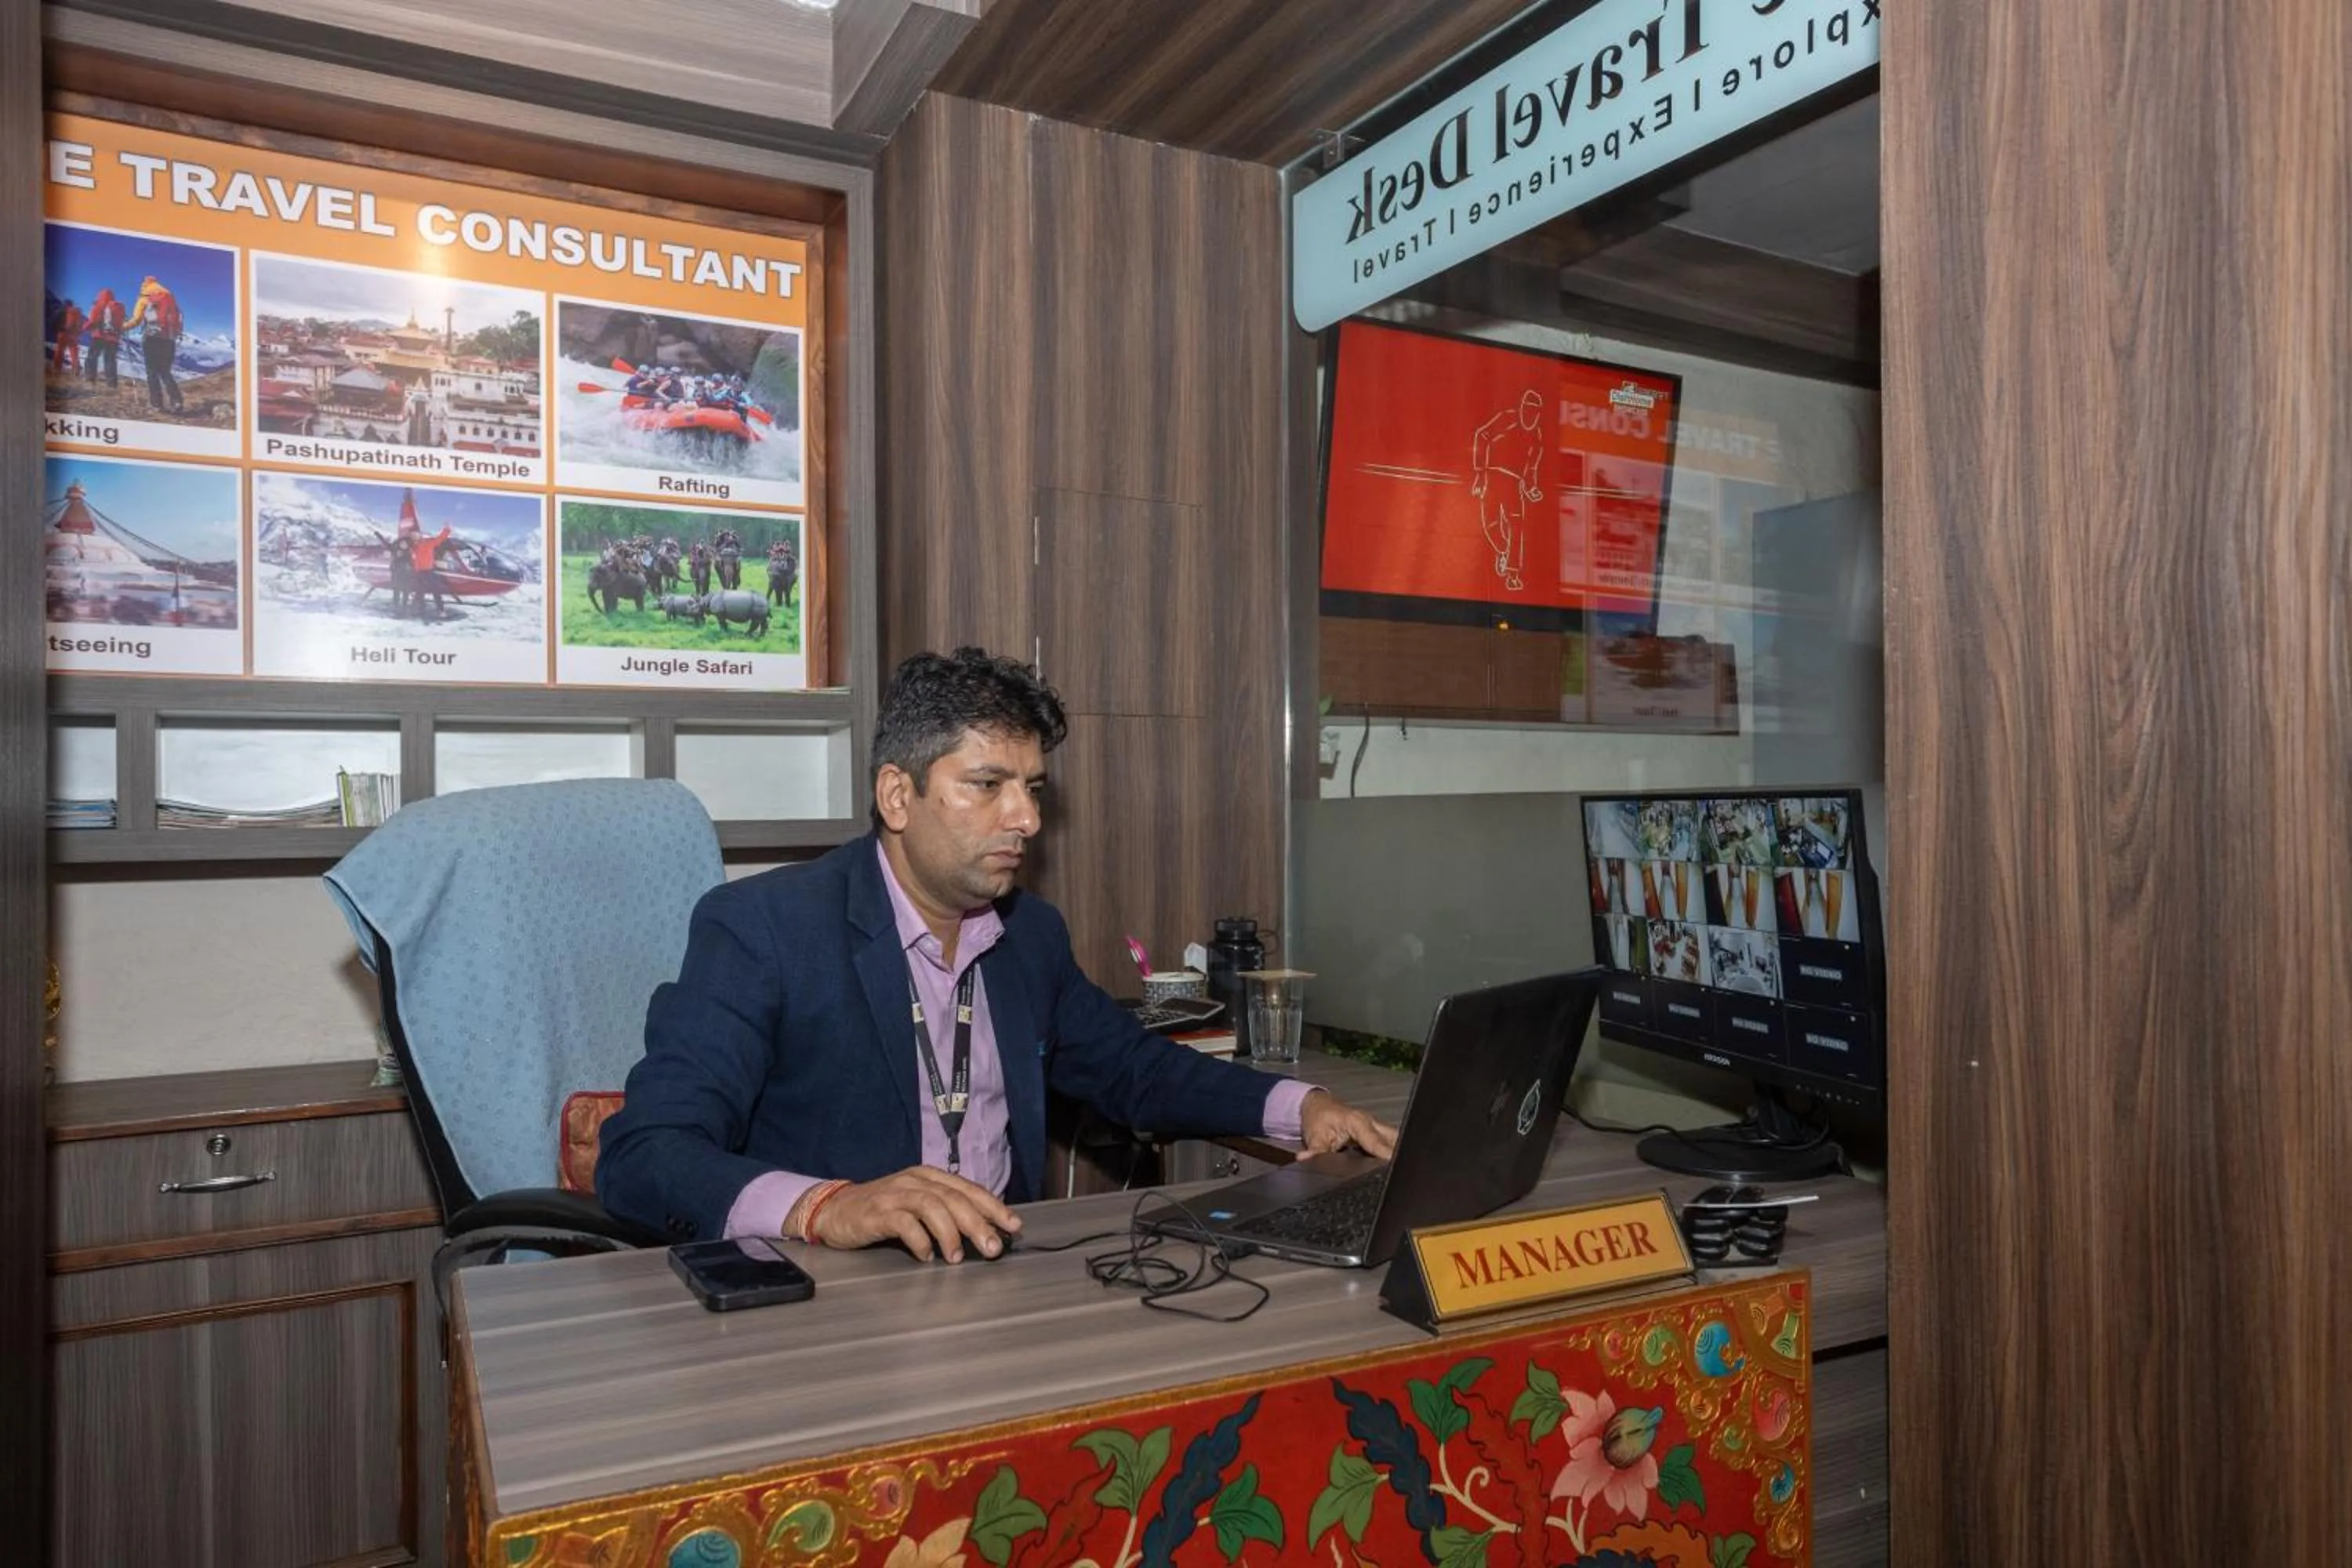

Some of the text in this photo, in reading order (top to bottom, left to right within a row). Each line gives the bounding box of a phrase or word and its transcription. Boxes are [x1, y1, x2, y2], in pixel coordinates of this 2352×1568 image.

[49, 140, 801, 298] E TRAVEL CONSULTANT
[45, 419, 118, 444] kking
[267, 439, 530, 477] Pashupatinath Temple
[659, 476, 730, 499] Rafting
[49, 635, 151, 658] tseeing
[351, 646, 457, 666] Heli Tour
[621, 656, 753, 676] Jungle Safari
[1450, 1221, 1659, 1290] MANAGER
